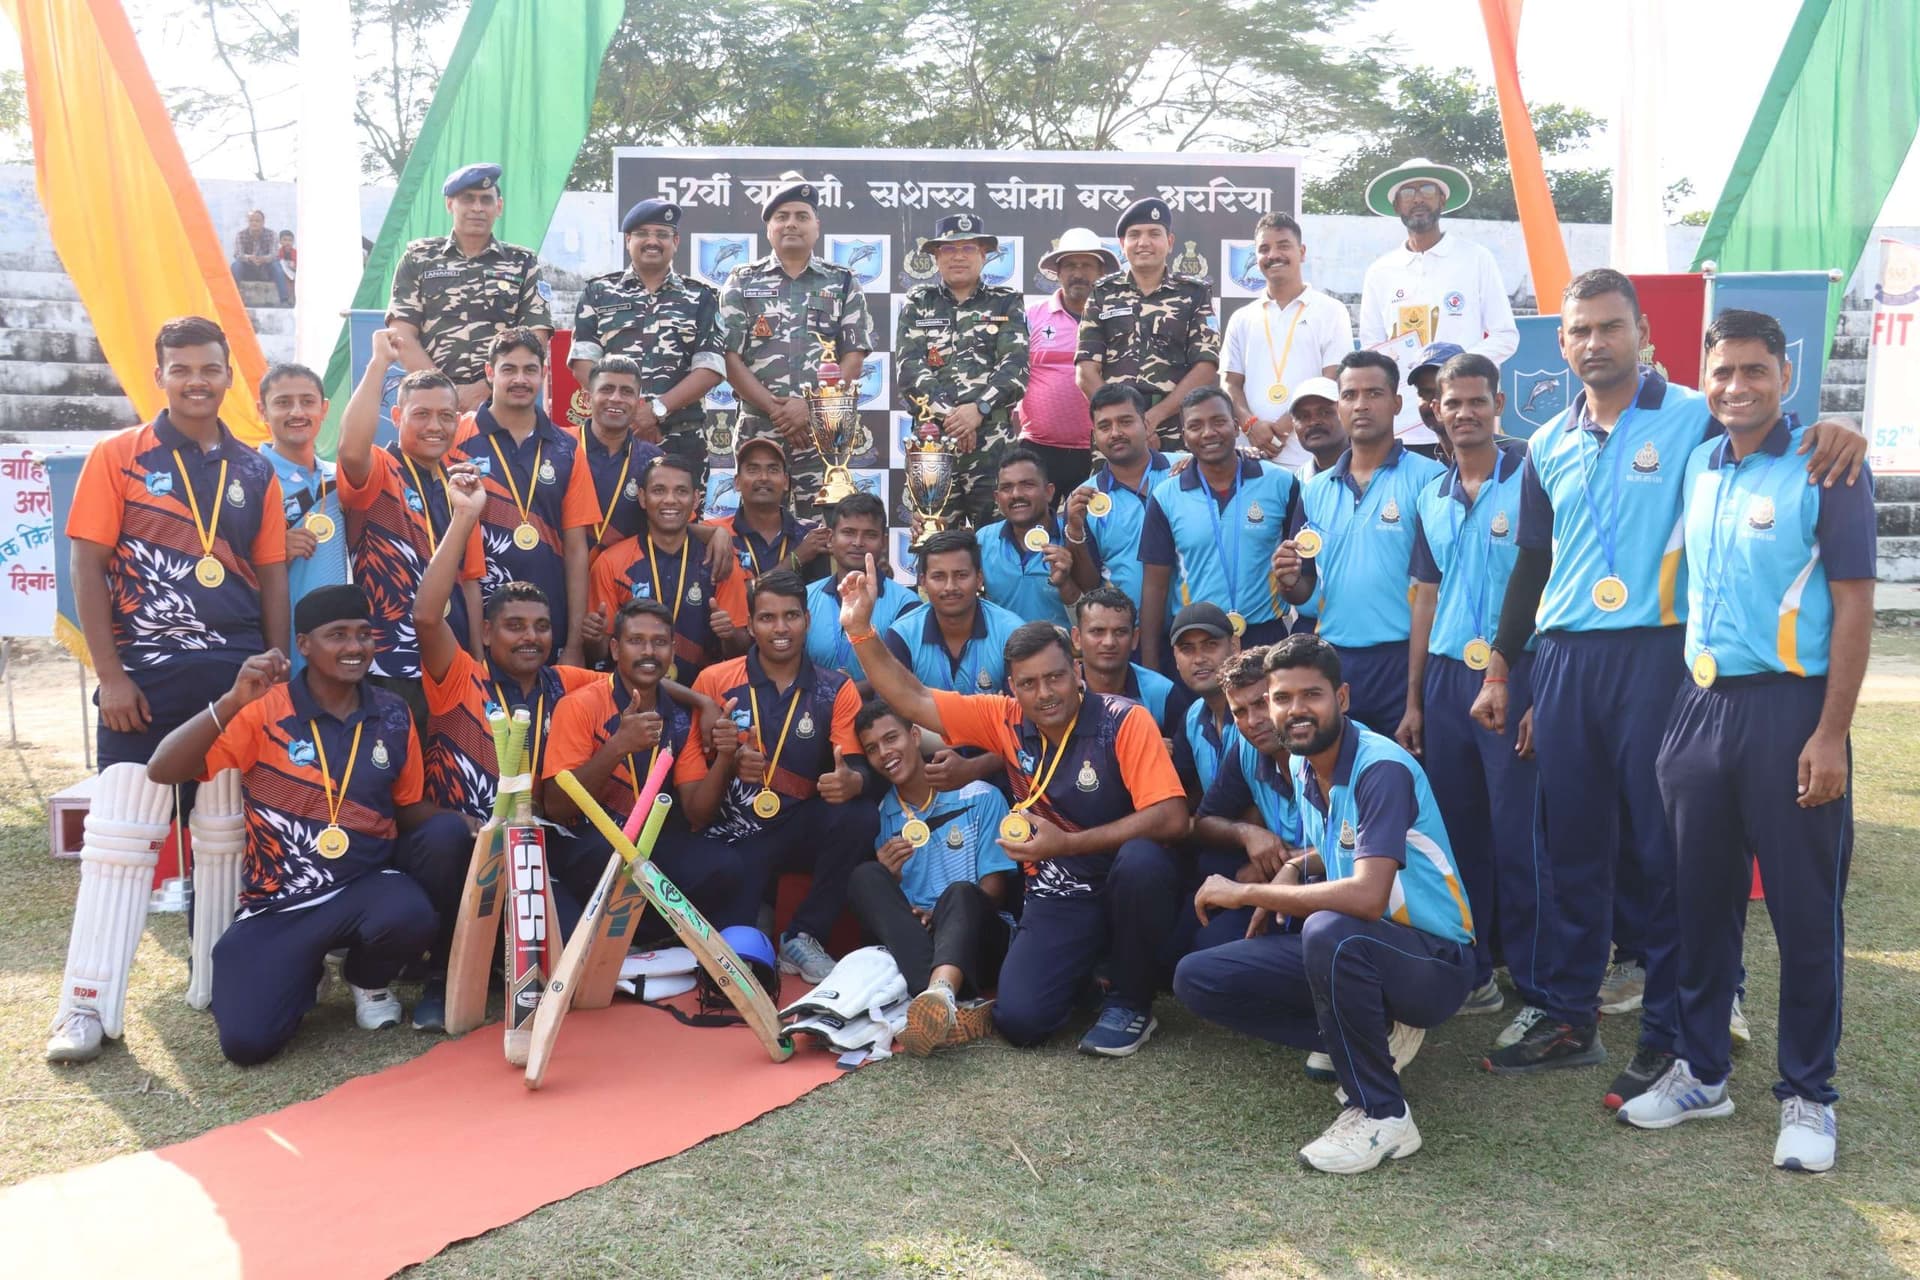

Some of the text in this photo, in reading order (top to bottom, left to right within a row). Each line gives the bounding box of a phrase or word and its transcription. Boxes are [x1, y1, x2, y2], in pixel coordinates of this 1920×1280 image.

[657, 172, 733, 207] 52वीं
[866, 180, 977, 210] सशस्त्र
[984, 175, 1067, 211] सीमा
[1156, 176, 1273, 214] अररिया
[913, 256, 931, 270] SSB
[1181, 261, 1199, 274] SSB
[1872, 312, 1914, 346] FIT
[713, 432, 731, 445] SSB
[0, 449, 48, 483] वाहि
[513, 844, 548, 942] SS
